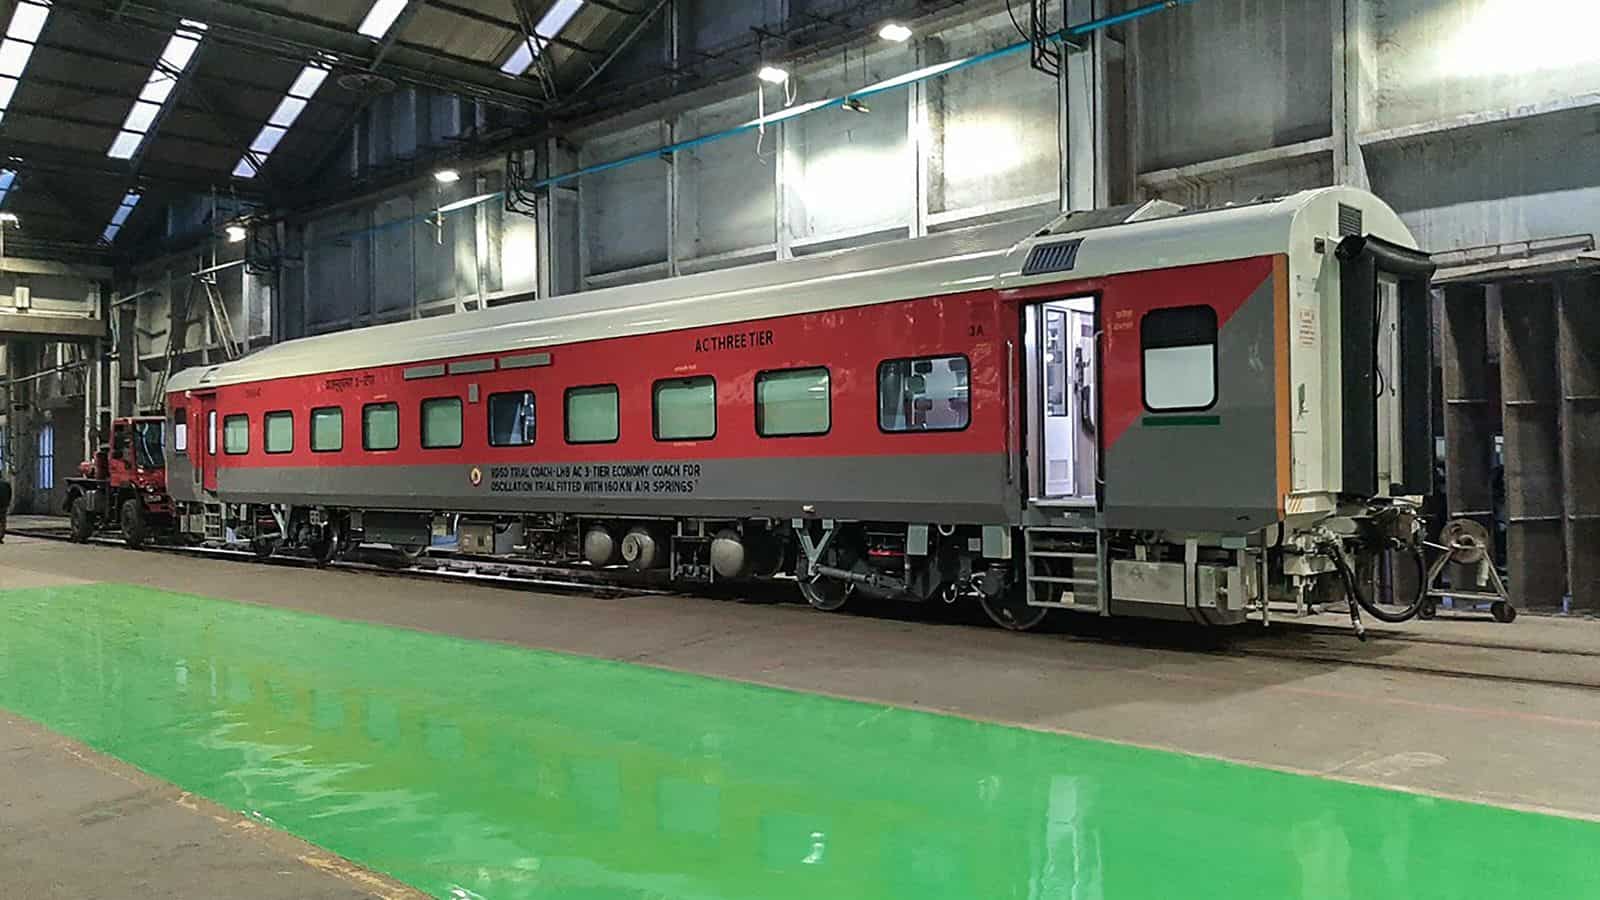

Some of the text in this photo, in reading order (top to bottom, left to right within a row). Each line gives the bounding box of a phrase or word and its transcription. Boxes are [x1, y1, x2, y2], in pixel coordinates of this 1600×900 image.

[695, 330, 774, 352] AC THREE TIER
[572, 465, 583, 477] AC
[612, 464, 649, 477] ECONOMY
[652, 463, 680, 477] COACH
[682, 463, 701, 477] FOR
[490, 481, 533, 492] OSCILLATION
[535, 481, 555, 492] TRIAL
[556, 481, 582, 492] FITTED
[583, 480, 603, 492] WITH
[634, 480, 650, 492] AIR
